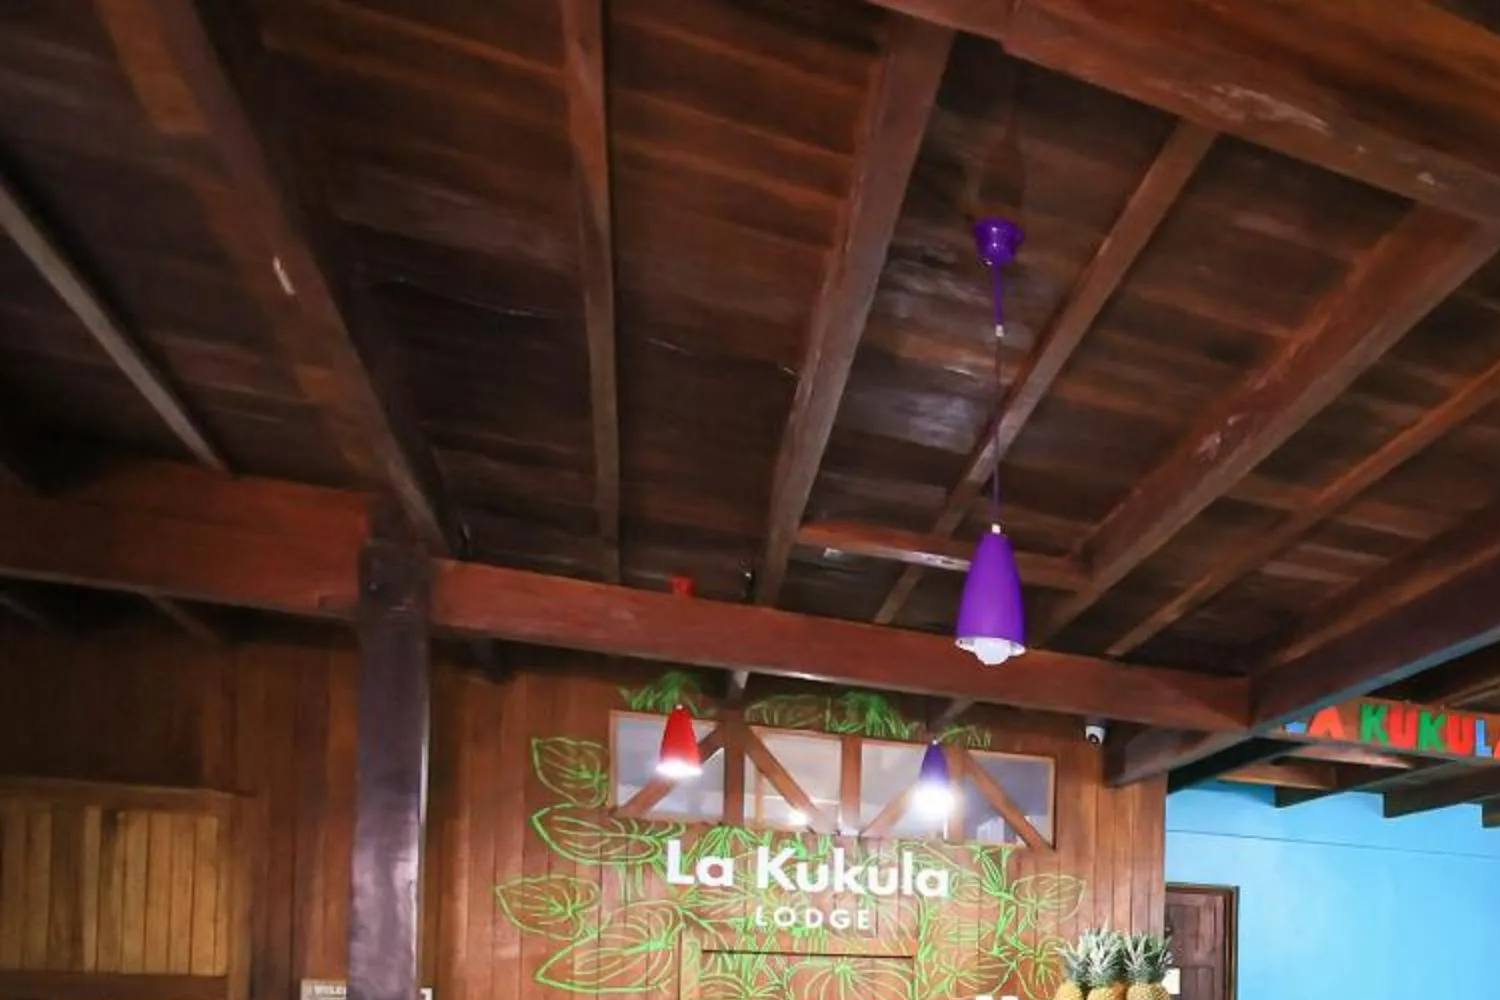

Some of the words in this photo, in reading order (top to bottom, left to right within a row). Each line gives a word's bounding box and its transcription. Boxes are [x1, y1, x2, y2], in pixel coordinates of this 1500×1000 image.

[1284, 706, 1345, 738] A
[667, 839, 735, 886] La
[756, 846, 950, 897] Kukula
[755, 905, 869, 931] LODGE
